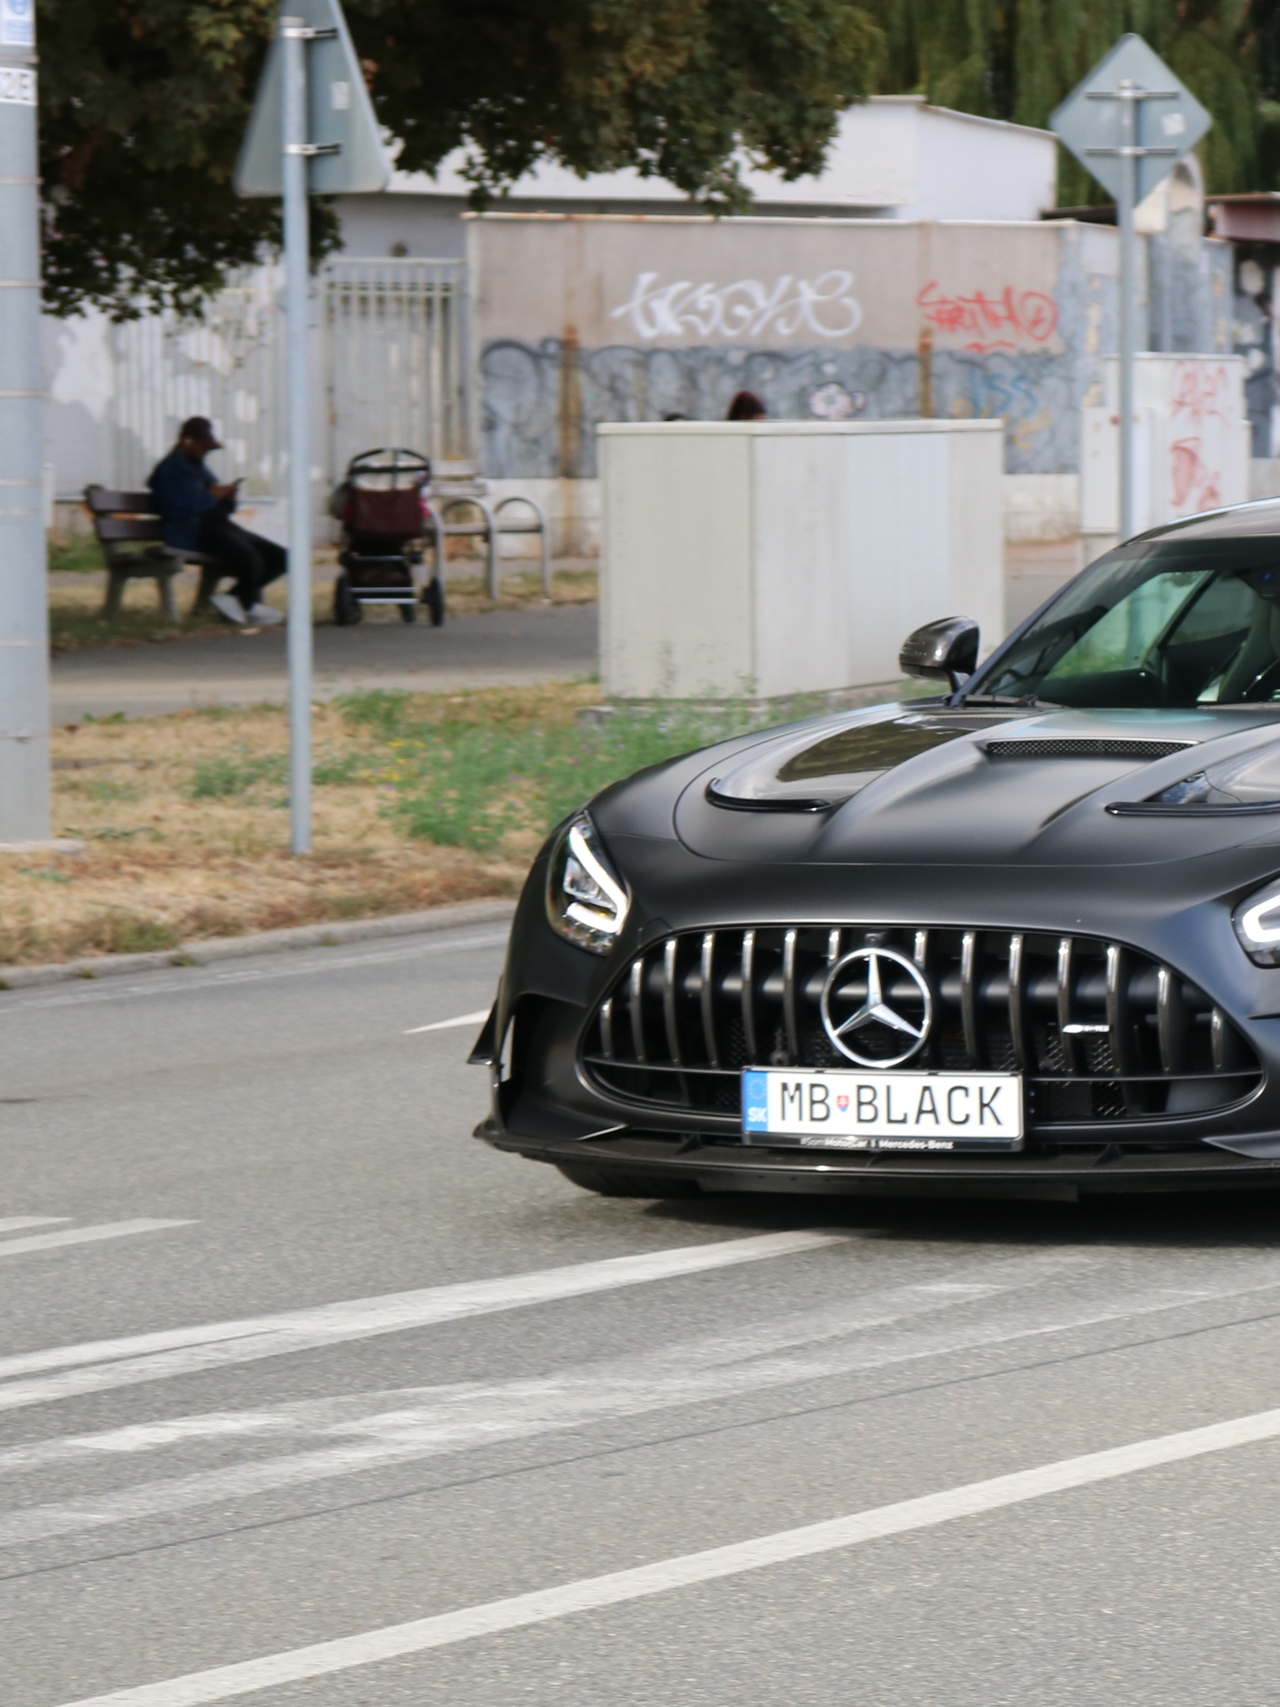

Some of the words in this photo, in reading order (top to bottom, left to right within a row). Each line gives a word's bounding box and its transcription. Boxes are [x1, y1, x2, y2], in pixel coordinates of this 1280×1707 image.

[780, 1082, 830, 1122] MB
[856, 1084, 1003, 1126] BLACK
[748, 1107, 767, 1123] SK
[878, 1138, 955, 1150] Mercedes-Benz
